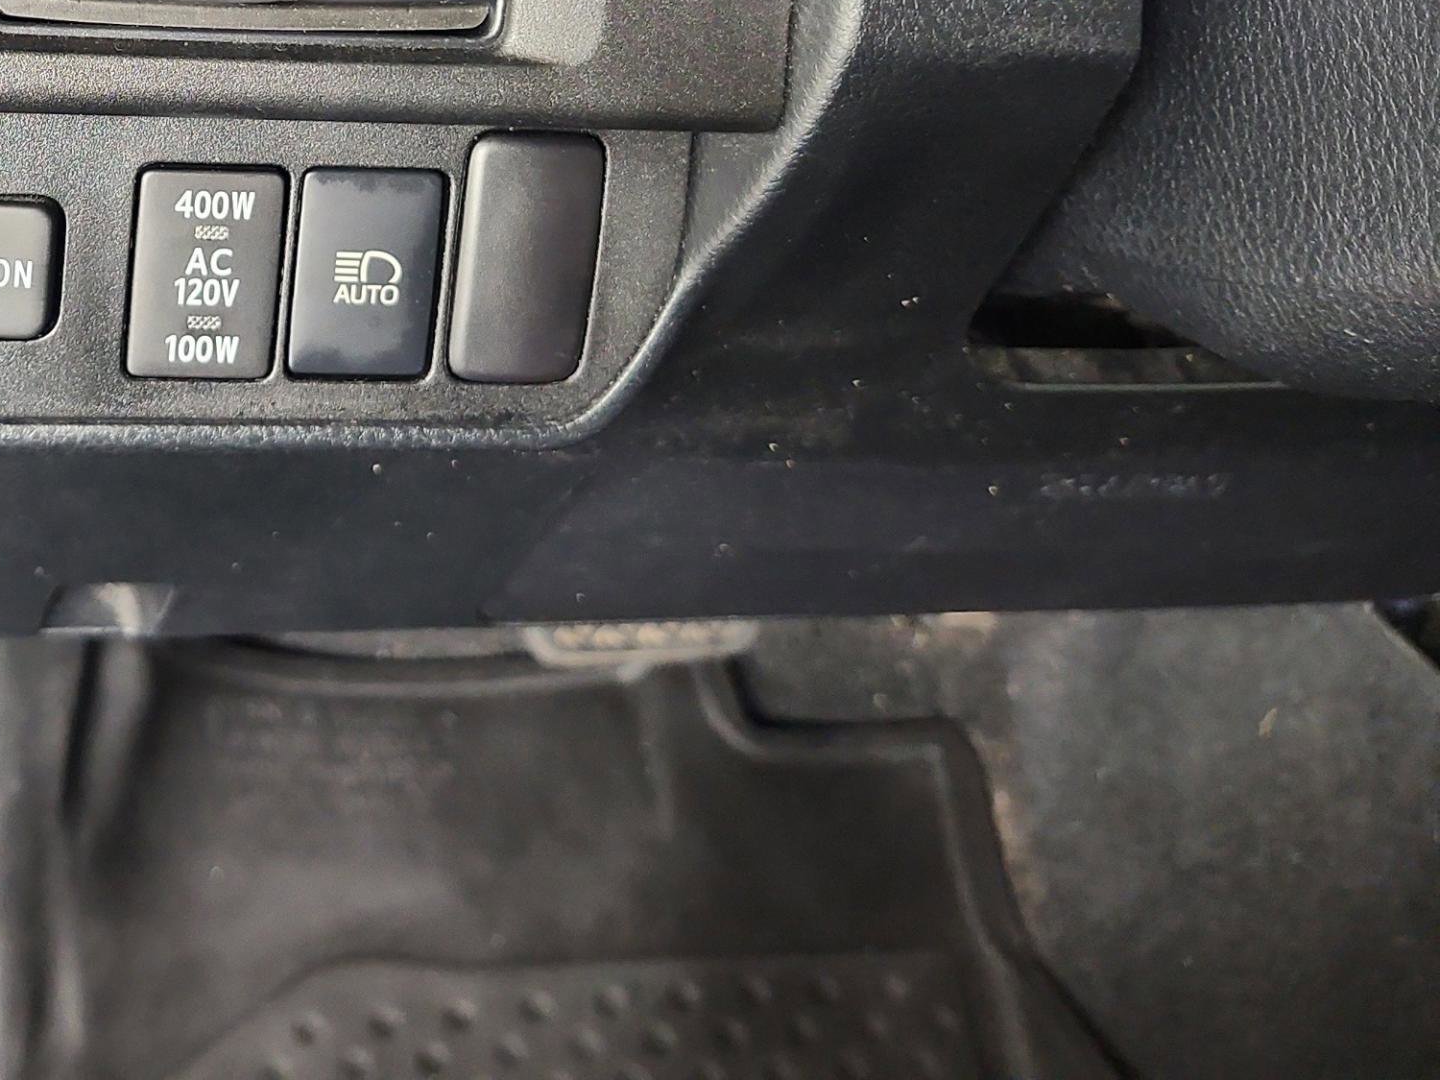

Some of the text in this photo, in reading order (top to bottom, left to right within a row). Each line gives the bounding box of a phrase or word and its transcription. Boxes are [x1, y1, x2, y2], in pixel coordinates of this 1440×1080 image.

[173, 190, 257, 221] 400W
[185, 246, 234, 276] AC
[173, 277, 240, 308] 120V
[333, 283, 401, 305] AUTO
[164, 334, 240, 364] 100W
